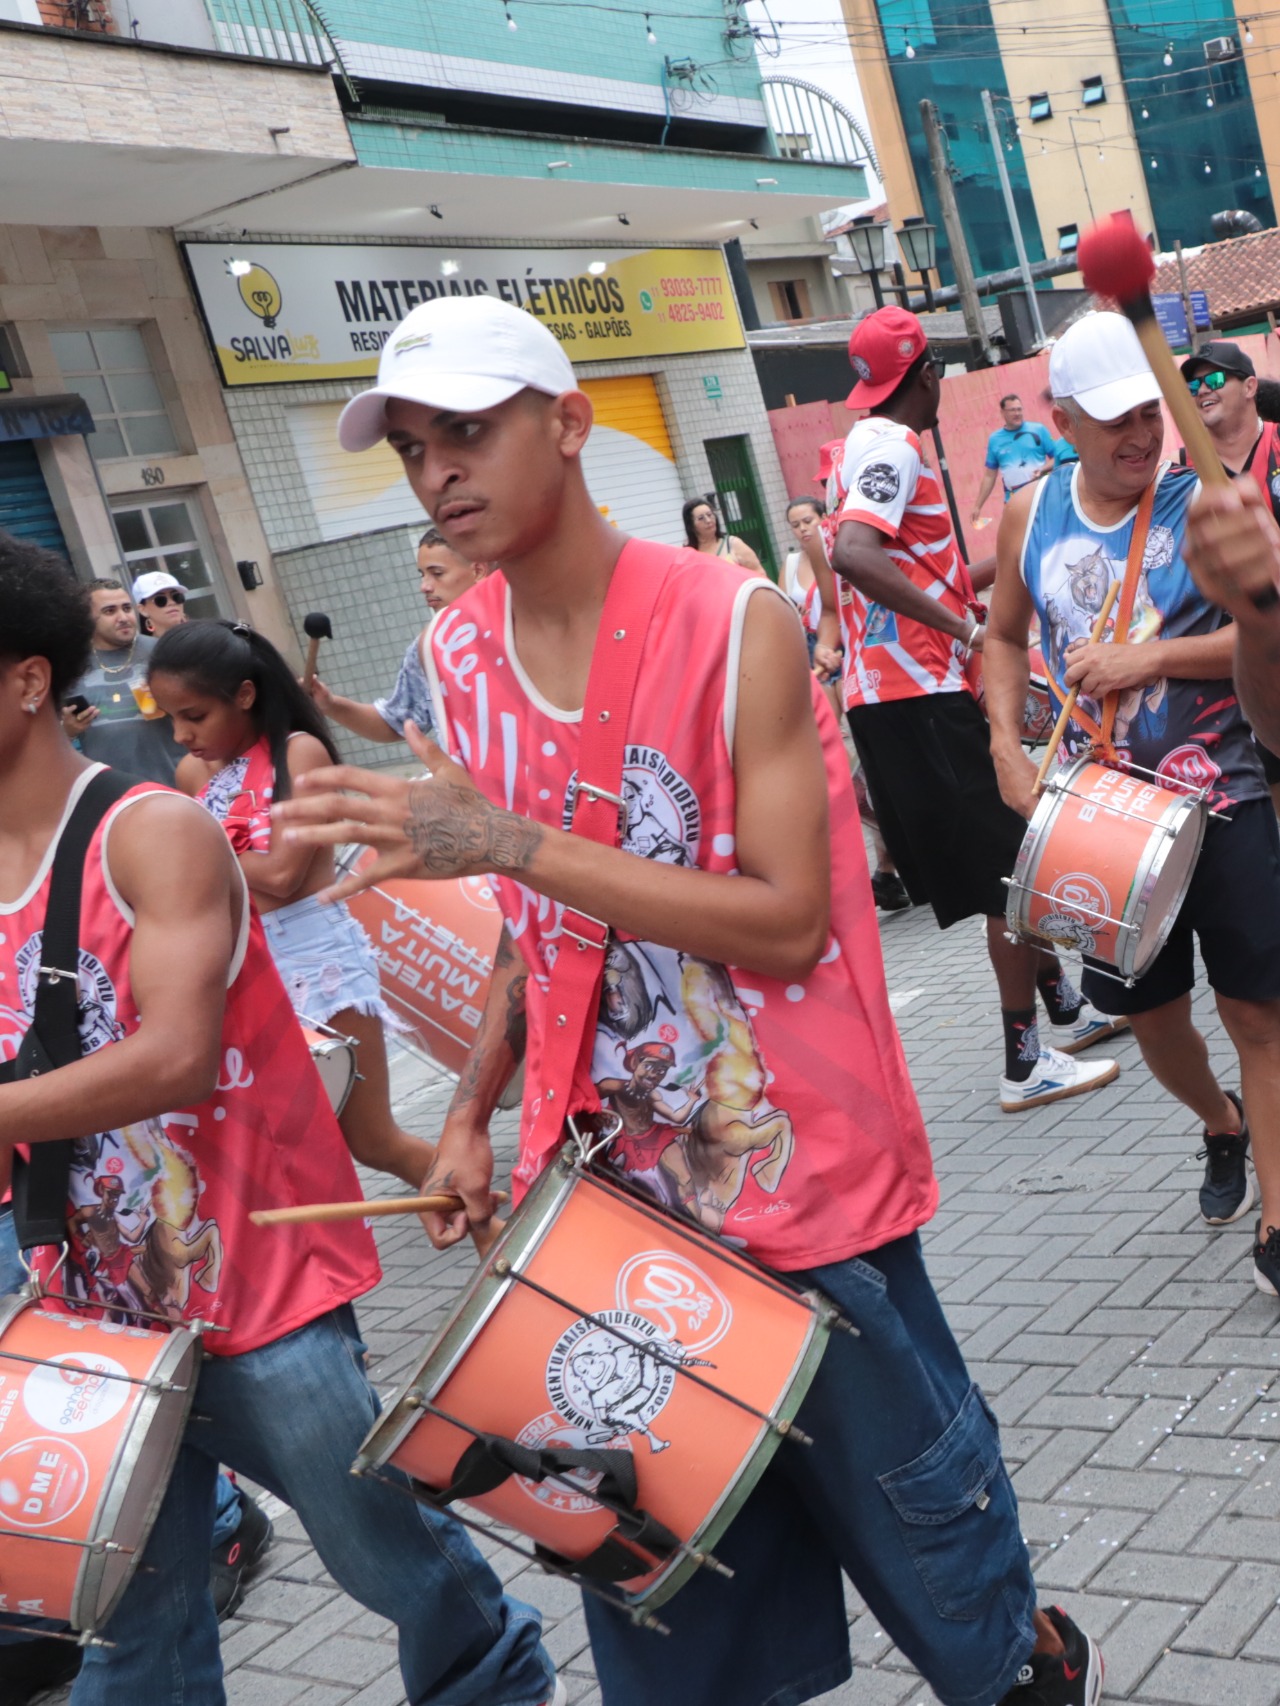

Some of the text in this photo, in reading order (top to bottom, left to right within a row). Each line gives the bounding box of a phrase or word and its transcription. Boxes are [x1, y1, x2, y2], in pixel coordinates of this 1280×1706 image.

[660, 277, 723, 298] 93033-7777
[585, 316, 632, 339] GALPÕES
[668, 302, 726, 323] 4825-9402
[230, 335, 292, 363] SALVA
[141, 466, 165, 486] 180
[866, 670, 880, 689] SP
[1077, 769, 1121, 823] BATER
[381, 919, 480, 998] MUITA
[393, 897, 493, 979] TRETA
[376, 950, 483, 1029] BATER
[688, 1291, 714, 1331] 2008
[60, 1385, 84, 1427] ganha
[72, 1362, 106, 1421] sempe
[647, 1374, 673, 1416] 2008
[24, 1451, 61, 1514] DME
